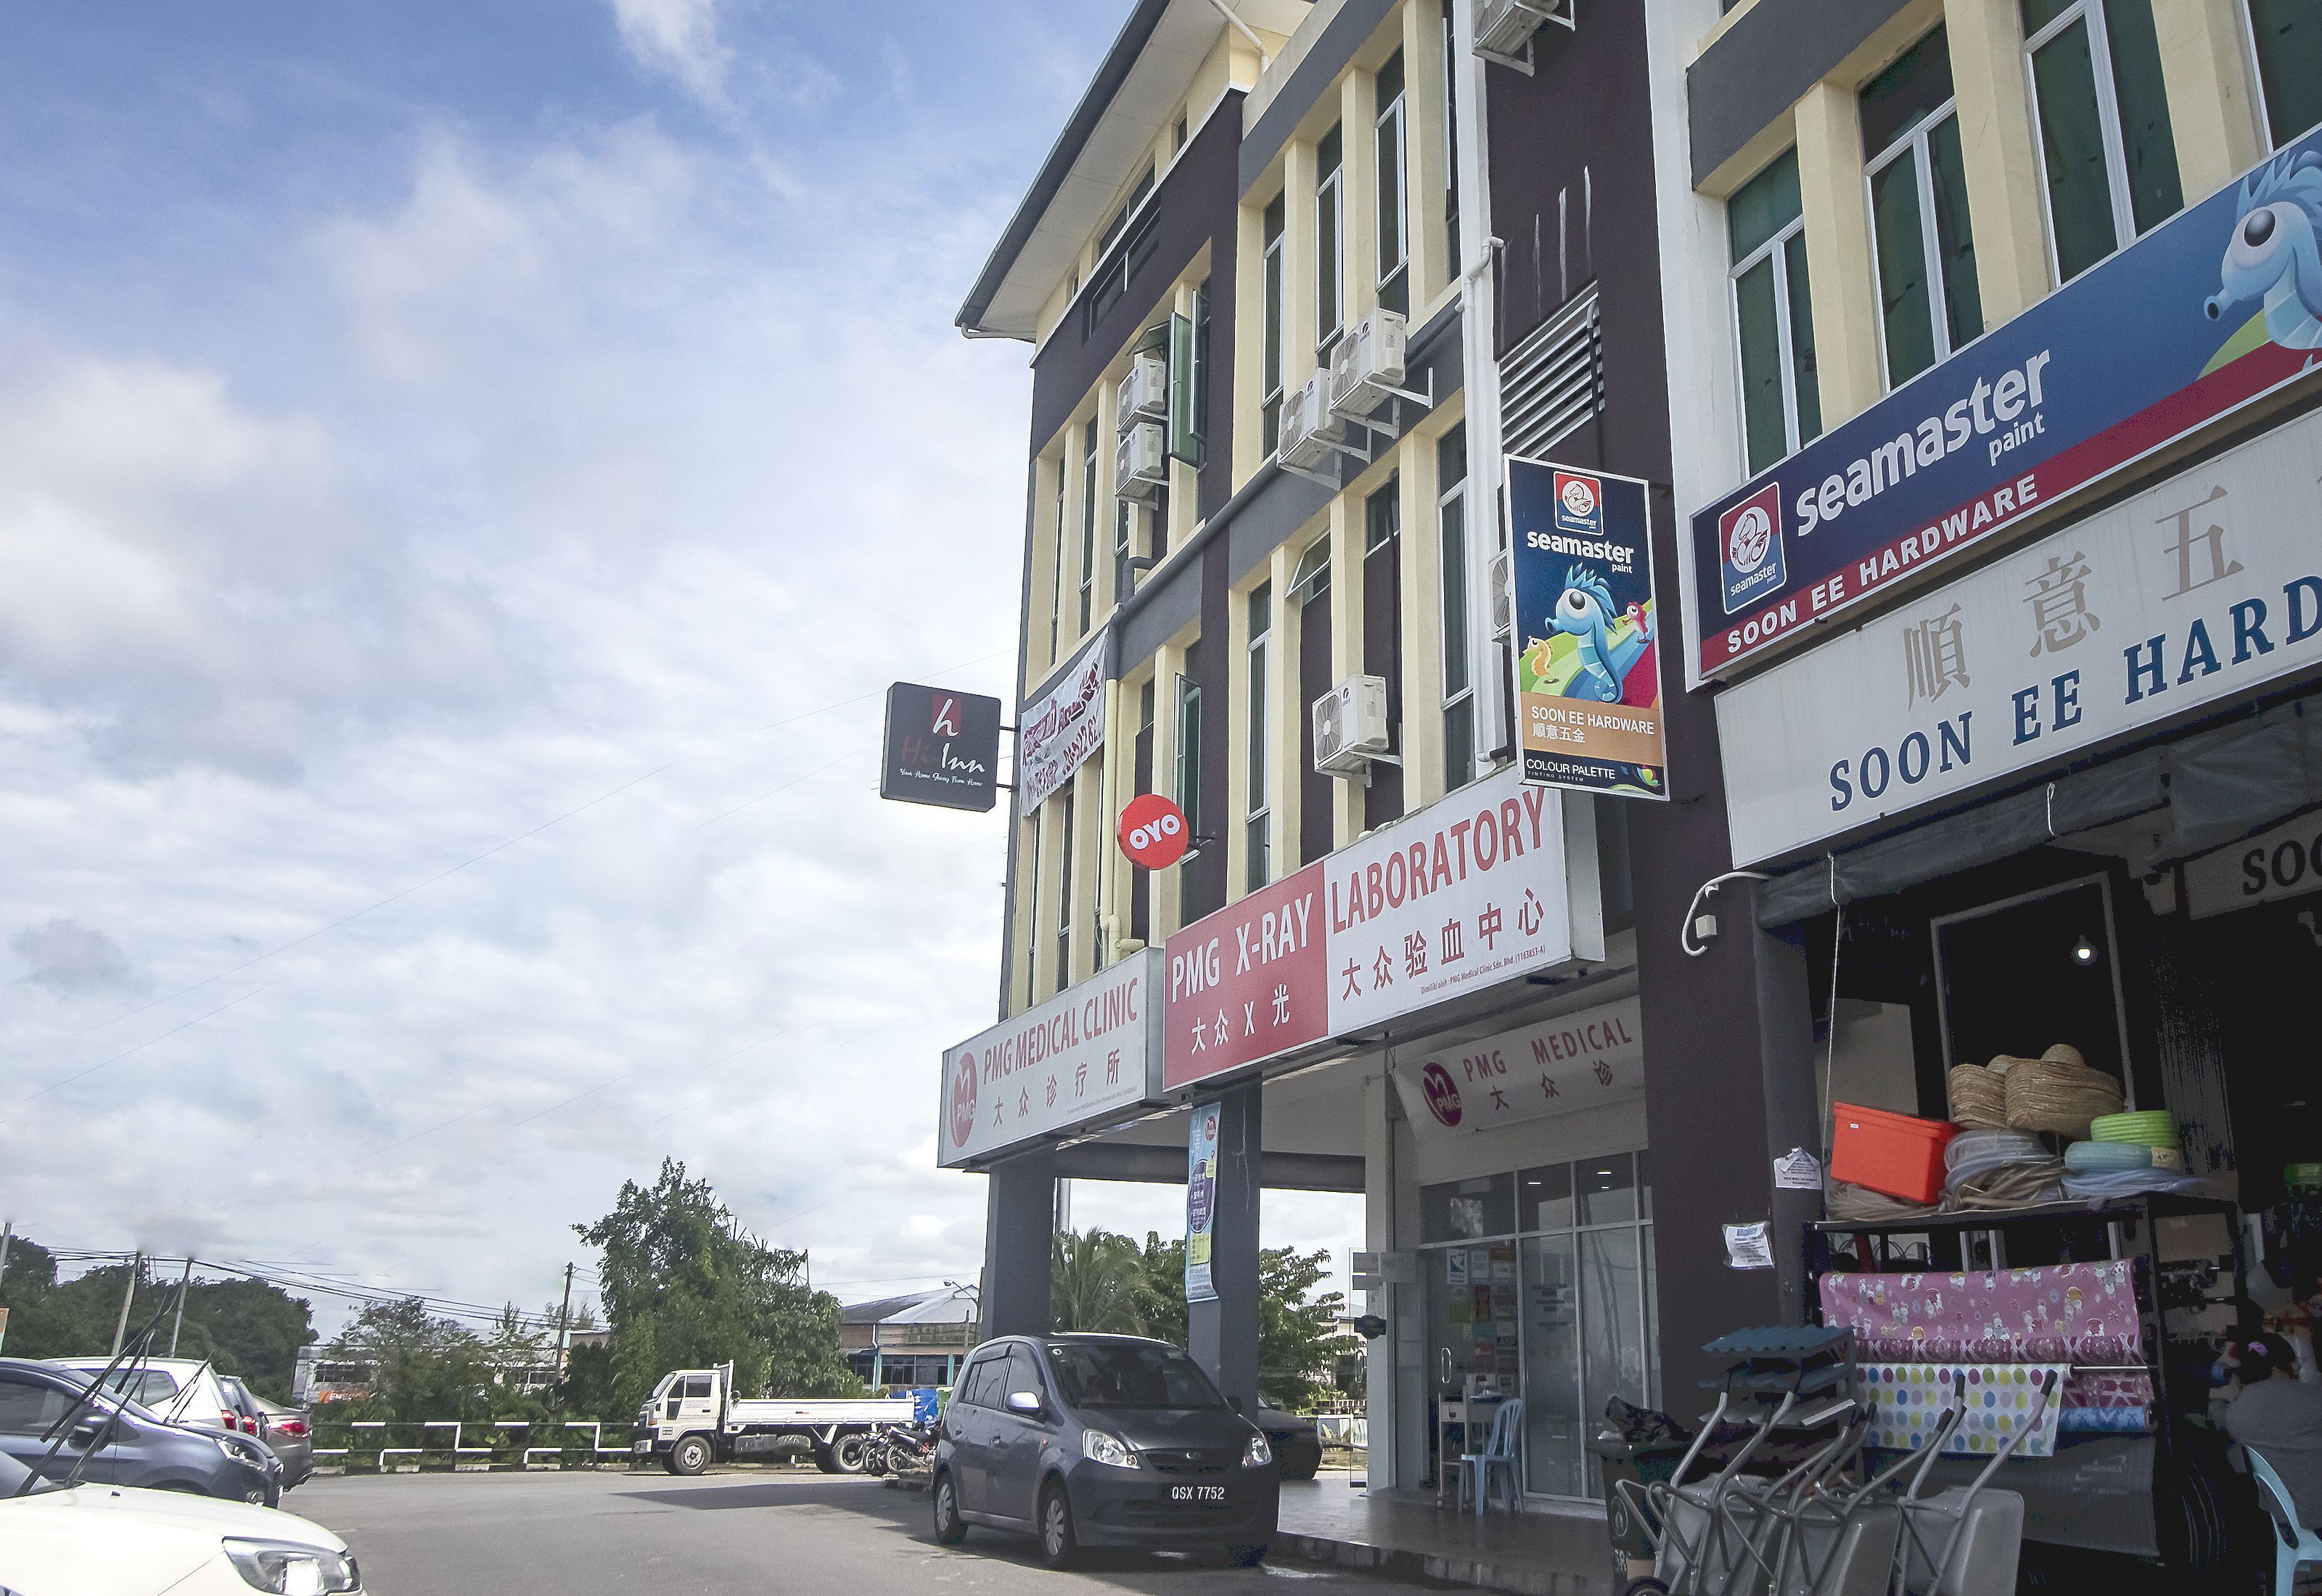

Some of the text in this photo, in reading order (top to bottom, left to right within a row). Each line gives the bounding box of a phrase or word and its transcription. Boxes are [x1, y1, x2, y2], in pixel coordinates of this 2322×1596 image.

[1797, 350, 2050, 538] seamaster
[1989, 410, 2046, 467] paint
[1562, 515, 1596, 526] seamaster
[1527, 531, 1634, 564] seamaster
[1727, 474, 2038, 653] SOON EE HARDWARE
[1612, 564, 1633, 574] paint
[1730, 562, 1776, 596] seamaster
[1903, 474, 2322, 712] 順意五
[1829, 575, 2322, 812] SOON EE HARD
[1531, 705, 1655, 735] SOON EE HARDWARE
[1526, 758, 1615, 779] COLOUR PALETTE
[1527, 770, 1554, 779] TINTING
[1129, 814, 1181, 850] OYO
[1331, 786, 1546, 935] LABORATORY
[1171, 892, 1313, 1003] PMG X-RAY
[1342, 887, 1544, 1002] 大众验血中心
[1450, 974, 1460, 984] PMG
[1461, 968, 1479, 981] Medical
[1479, 964, 1493, 975] Clinic
[983, 977, 1138, 1085] PMG MEDICAL CLINIC
[1462, 1018, 1633, 1082] PMG MEDICAL
[993, 1048, 1120, 1127] 大众诊疗所
[1437, 1093, 1460, 1111] PMG
[958, 1098, 975, 1124] PMG
[1172, 1486, 1224, 1500] QSX 7752
